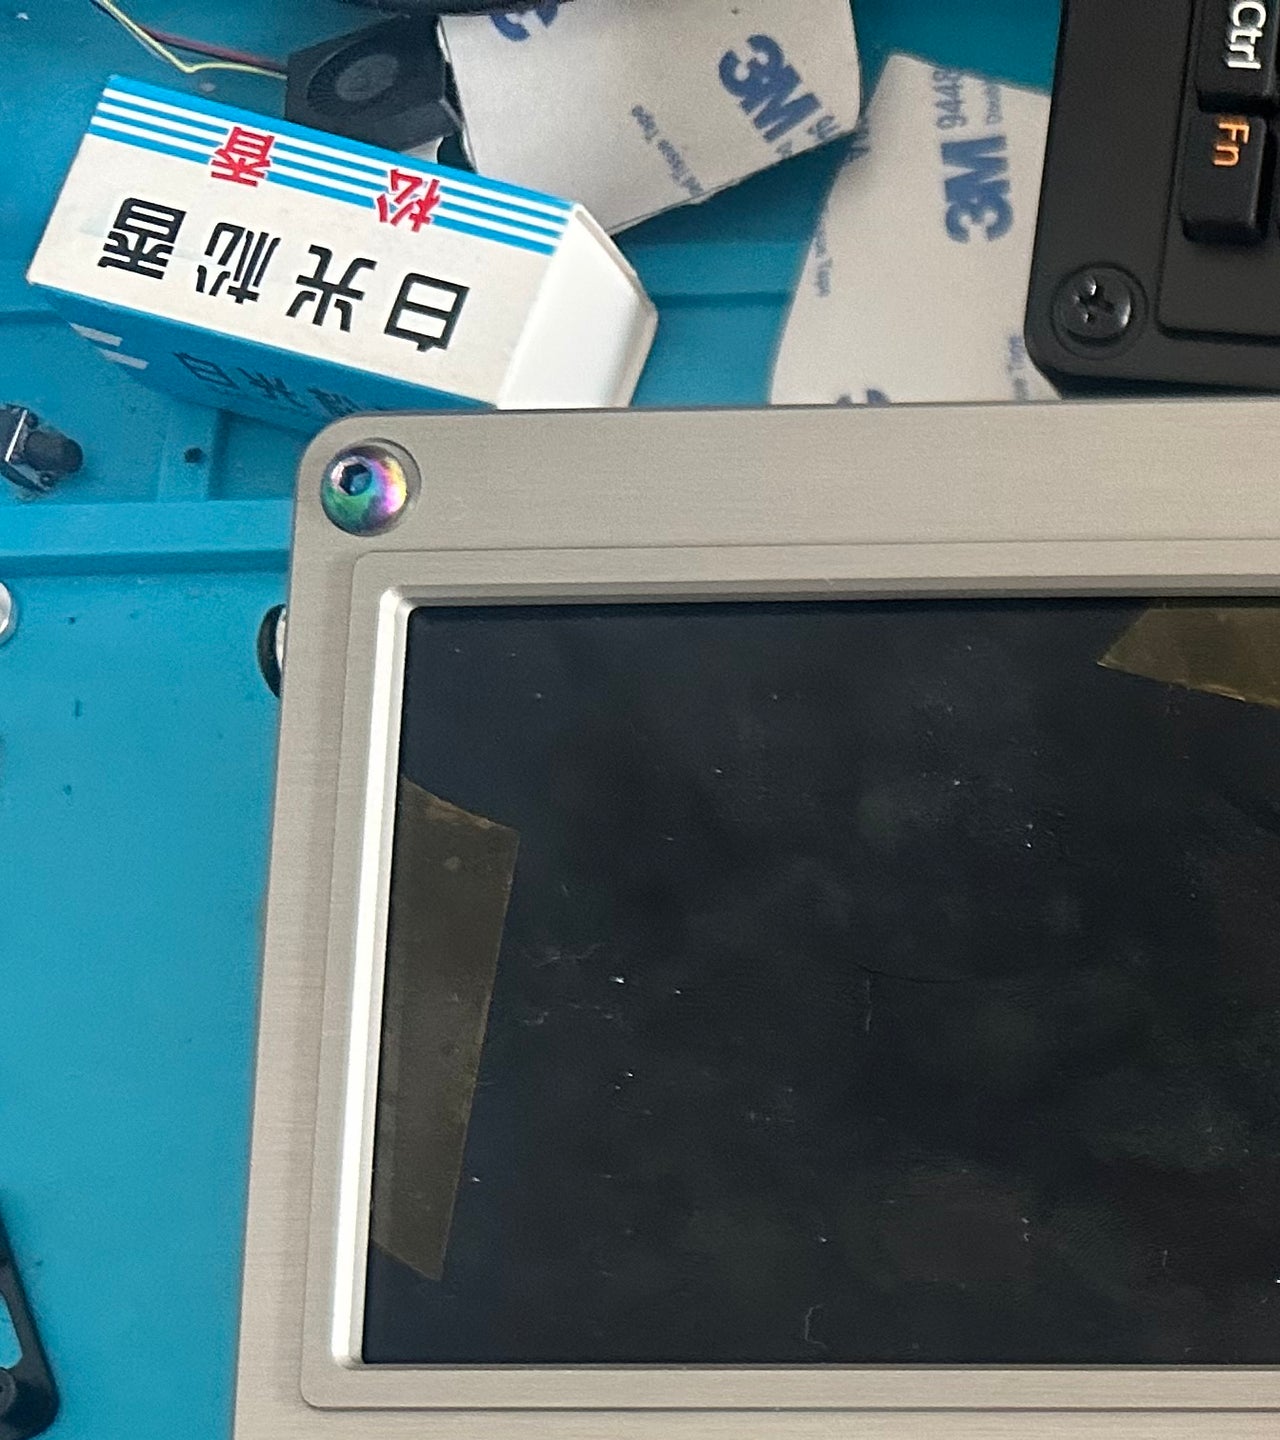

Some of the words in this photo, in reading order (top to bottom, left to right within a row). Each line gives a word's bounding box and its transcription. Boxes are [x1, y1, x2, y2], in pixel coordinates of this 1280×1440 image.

[719, 34, 822, 143] 3M
[1225, 1, 1266, 69] Ctrl
[942, 135, 1013, 244] 3M
[1212, 118, 1250, 166] Fn
[97, 197, 471, 352] 白光松香
